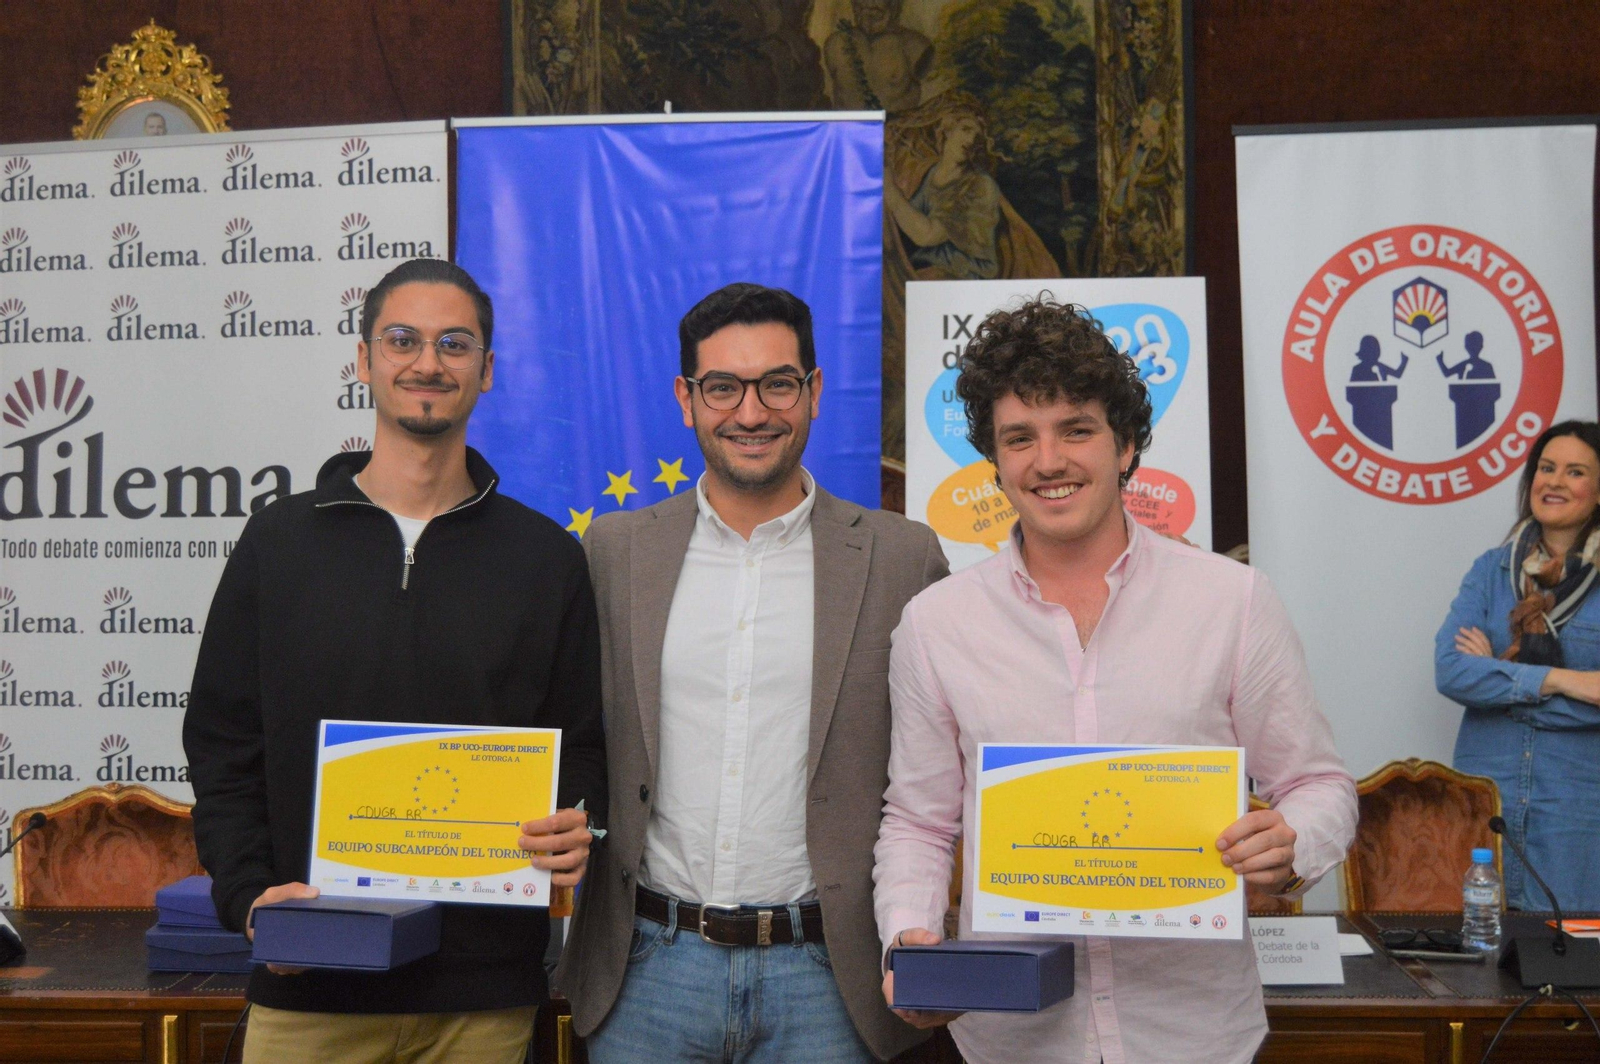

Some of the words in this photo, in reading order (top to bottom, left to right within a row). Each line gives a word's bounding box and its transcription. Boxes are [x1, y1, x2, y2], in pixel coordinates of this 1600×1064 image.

[1290, 271, 1350, 362] AULA
[1349, 237, 1399, 275] DE
[1410, 232, 1555, 356] ORATORIA
[943, 314, 973, 340] IX
[1309, 414, 1338, 439] Y
[1331, 442, 1473, 499] DEBATE
[1477, 411, 1542, 478] UCO
[972, 500, 990, 515] 10
[993, 497, 1003, 507] a
[1130, 499, 1160, 510] CCEE
[973, 518, 992, 533] de
[2, 538, 37, 559] Todo
[43, 538, 98, 559] debate
[104, 537, 181, 559] comienza
[188, 540, 217, 558] con
[450, 743, 461, 751] BP
[463, 743, 516, 753] UCO-EUROPE
[517, 745, 548, 754] DIRECT
[481, 755, 513, 763] OTORGA
[1108, 763, 1119, 771] IX
[1134, 764, 1194, 773] UCO-EUROPE
[1196, 765, 1230, 773] DIRECT
[1156, 775, 1191, 783] OTORGA
[405, 830, 415, 838] EL
[417, 829, 449, 840] TÍTULO
[450, 832, 461, 840] DE
[328, 841, 373, 854] EQUIPO
[375, 842, 458, 857] SUBCAMPEÓN
[461, 847, 485, 857] DEL
[1074, 859, 1086, 867] EL
[1088, 858, 1124, 868] TÍTULO
[1125, 860, 1138, 869] DE
[990, 873, 1040, 886] EQUIPO
[1042, 873, 1136, 887] SUBCAMPEÓN
[1139, 877, 1166, 888] DEL
[1168, 877, 1226, 889] TORNEO
[1252, 925, 1285, 937] LÓPEZ
[1258, 942, 1292, 951] Debate
[1296, 941, 1308, 950] de
[1310, 940, 1320, 950] la
[1262, 954, 1303, 964] Córdoba
